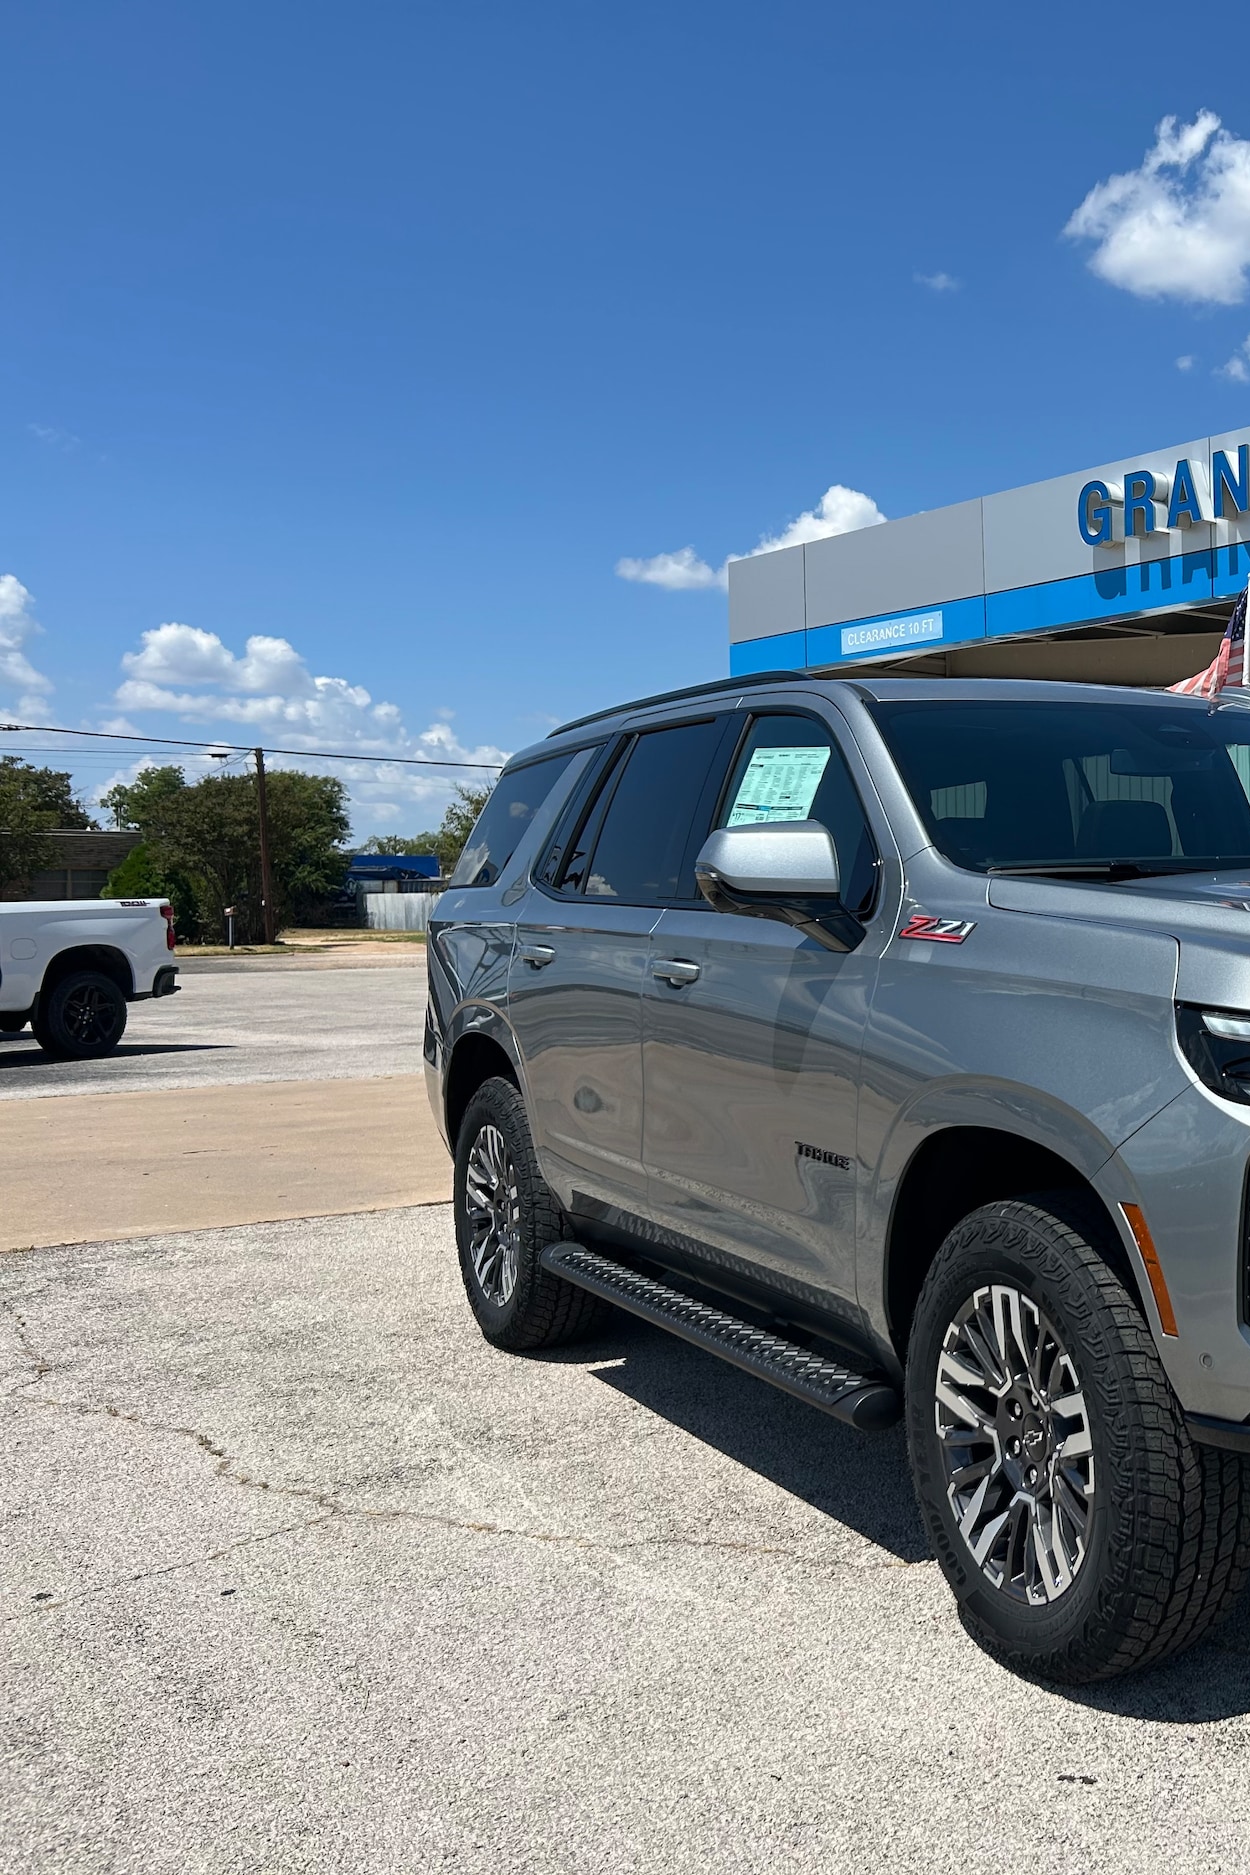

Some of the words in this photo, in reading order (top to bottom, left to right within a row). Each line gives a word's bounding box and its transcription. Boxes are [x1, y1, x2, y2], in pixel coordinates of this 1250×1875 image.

[848, 623, 906, 646] CLEARANCE
[909, 622, 919, 635] 10
[922, 618, 934, 633] FT
[899, 914, 978, 945] Z71
